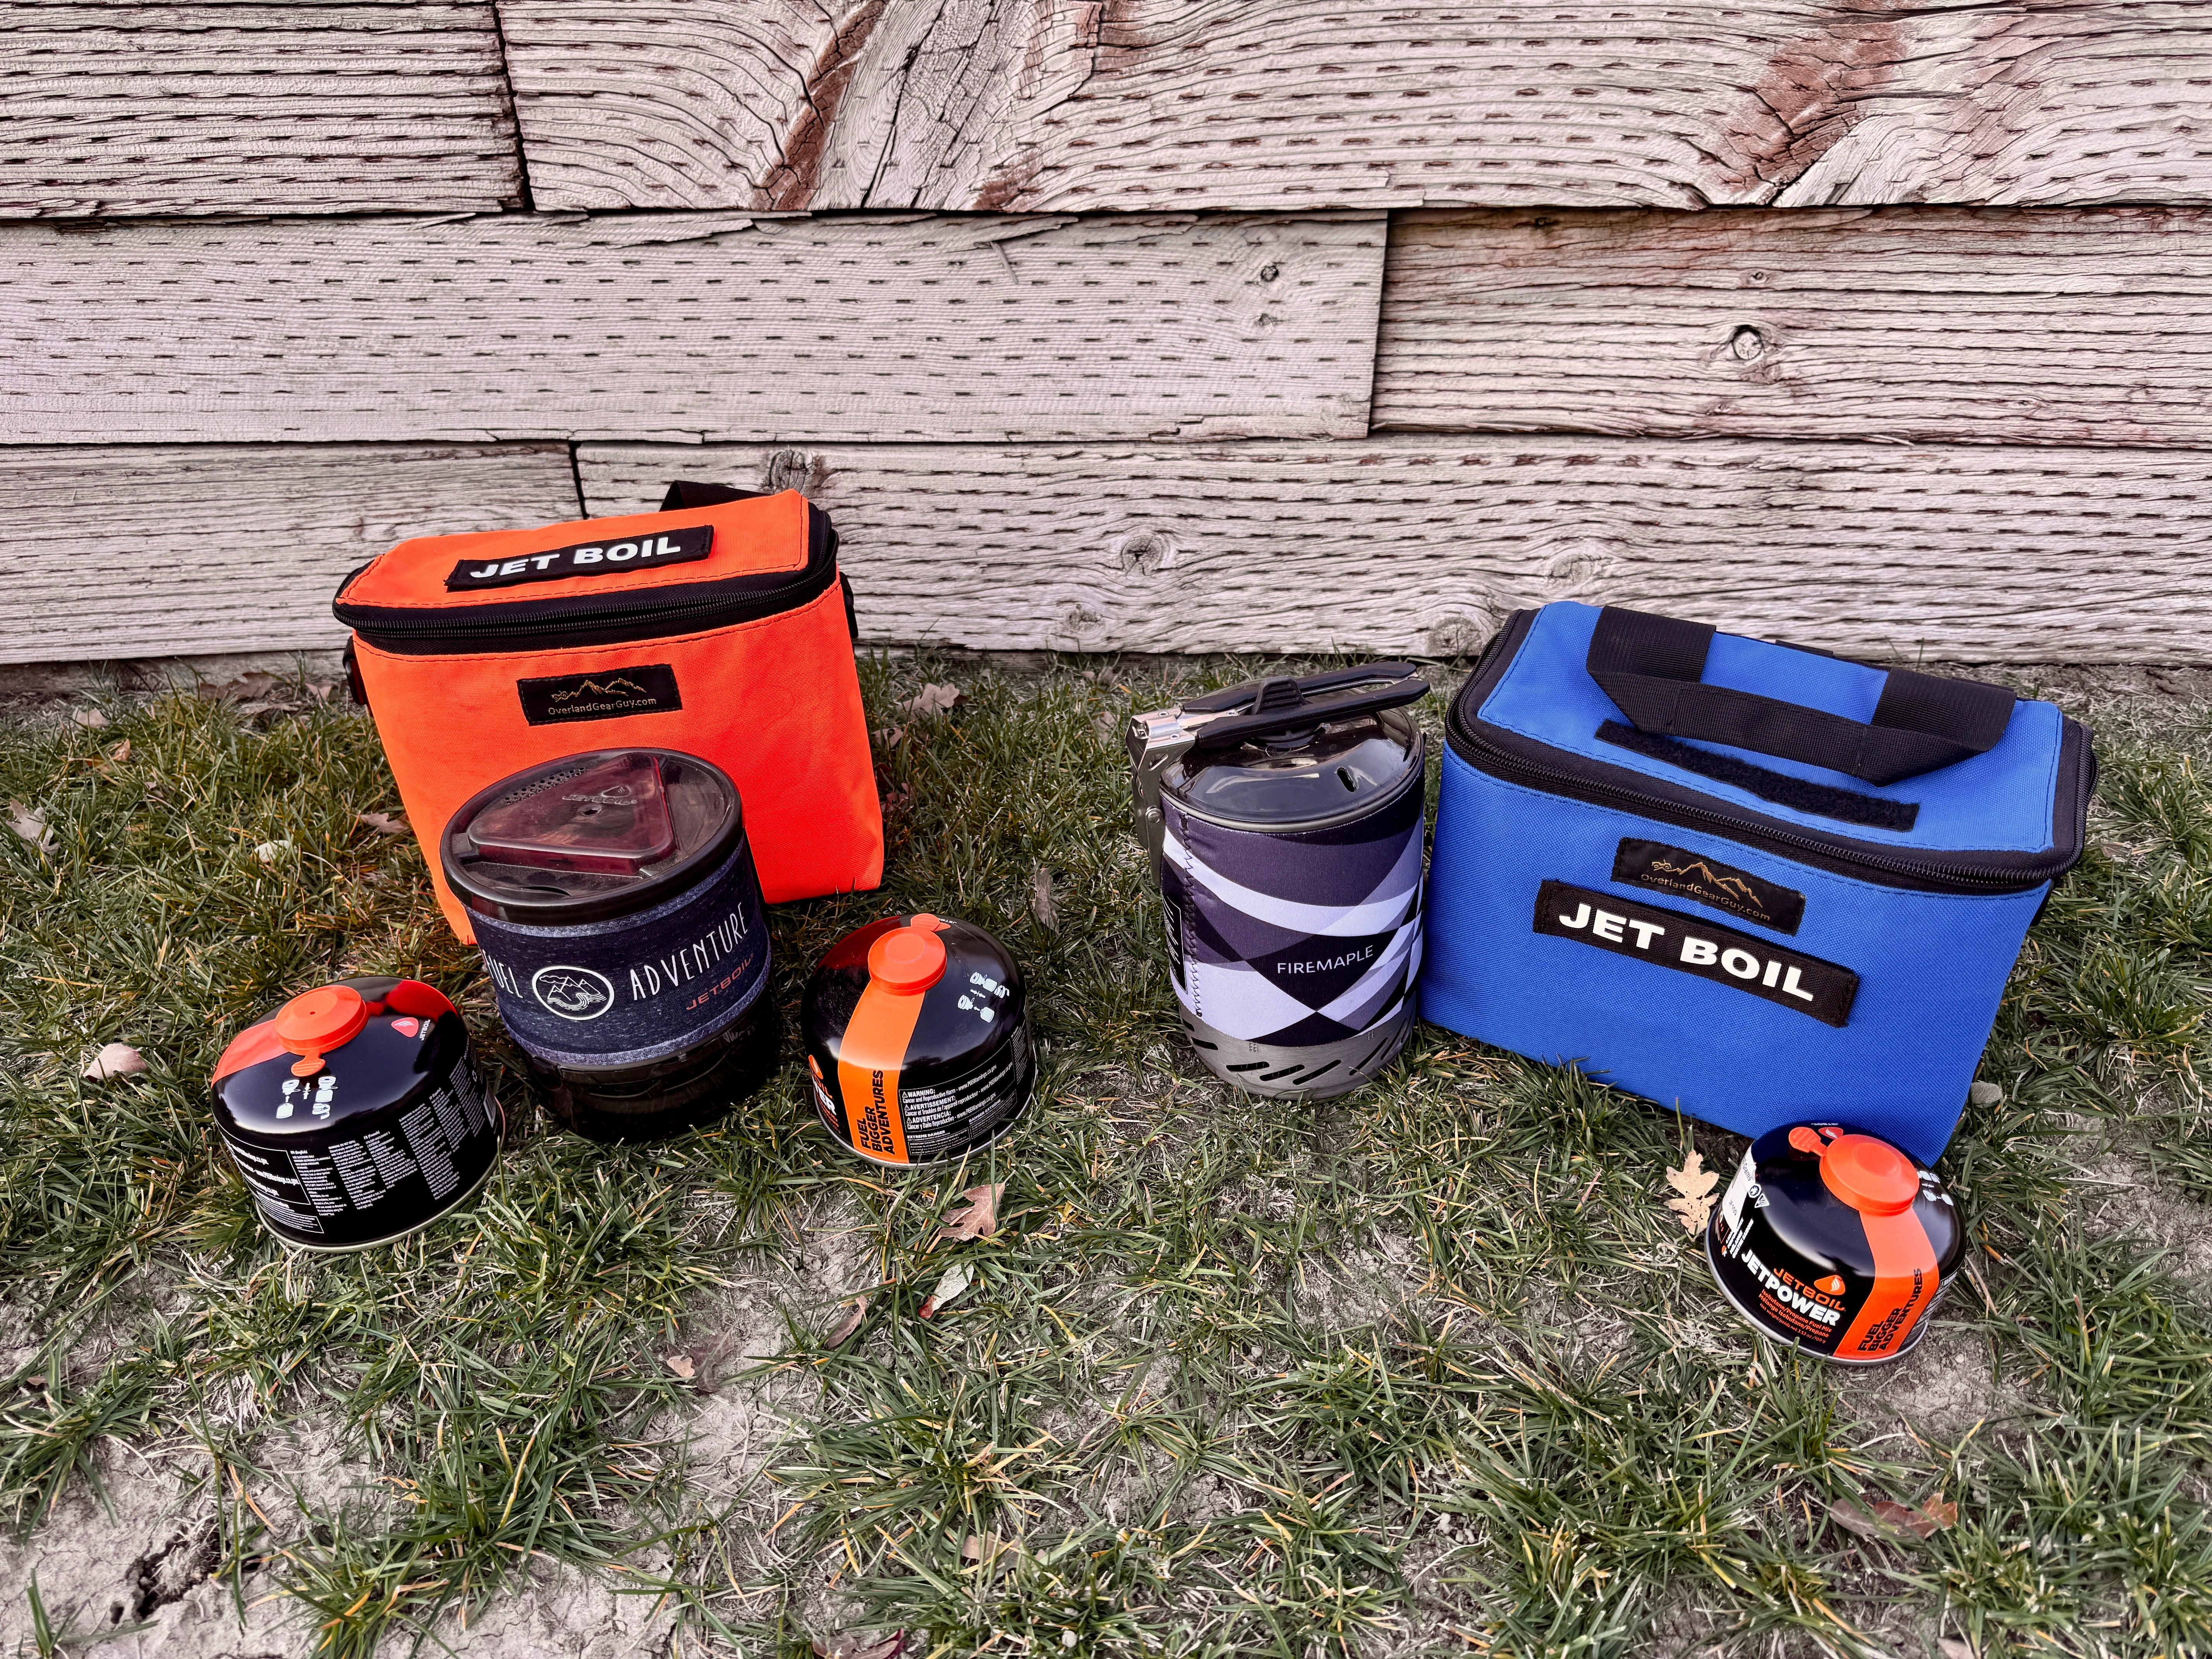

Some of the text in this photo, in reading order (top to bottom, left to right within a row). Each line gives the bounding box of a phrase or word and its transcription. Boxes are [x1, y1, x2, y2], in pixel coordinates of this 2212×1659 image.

[470, 537, 681, 579] JET BOIL
[548, 698, 657, 715] OverlandGearGuy.com
[1641, 874, 1771, 921] OverlandGearGuy.com
[483, 902, 748, 1001] FUEL ADVENTURE
[1278, 945, 1373, 974] FIREMAPLE
[1559, 903, 1814, 1002] JET BOIL
[419, 1019, 431, 1041] JETBOIL
[872, 1070, 895, 1155] ADVENTURES
[907, 1089, 935, 1097] WARNING:
[910, 1096, 956, 1110] AVERTISSEMENT:
[857, 1118, 872, 1149] FUEL
[864, 1106, 883, 1152] BIGGER
[912, 1111, 951, 1123] ADVERTENCIA:
[1741, 1250, 1840, 1326] JETPOWER
[1774, 1268, 1845, 1311] JETBOIL
[1809, 1321, 1822, 1329] Fuel
[1867, 1307, 1903, 1351] BIGGER
[1878, 1268, 1923, 1351] ADVENTURES
[1856, 1320, 1884, 1351] FUEL
